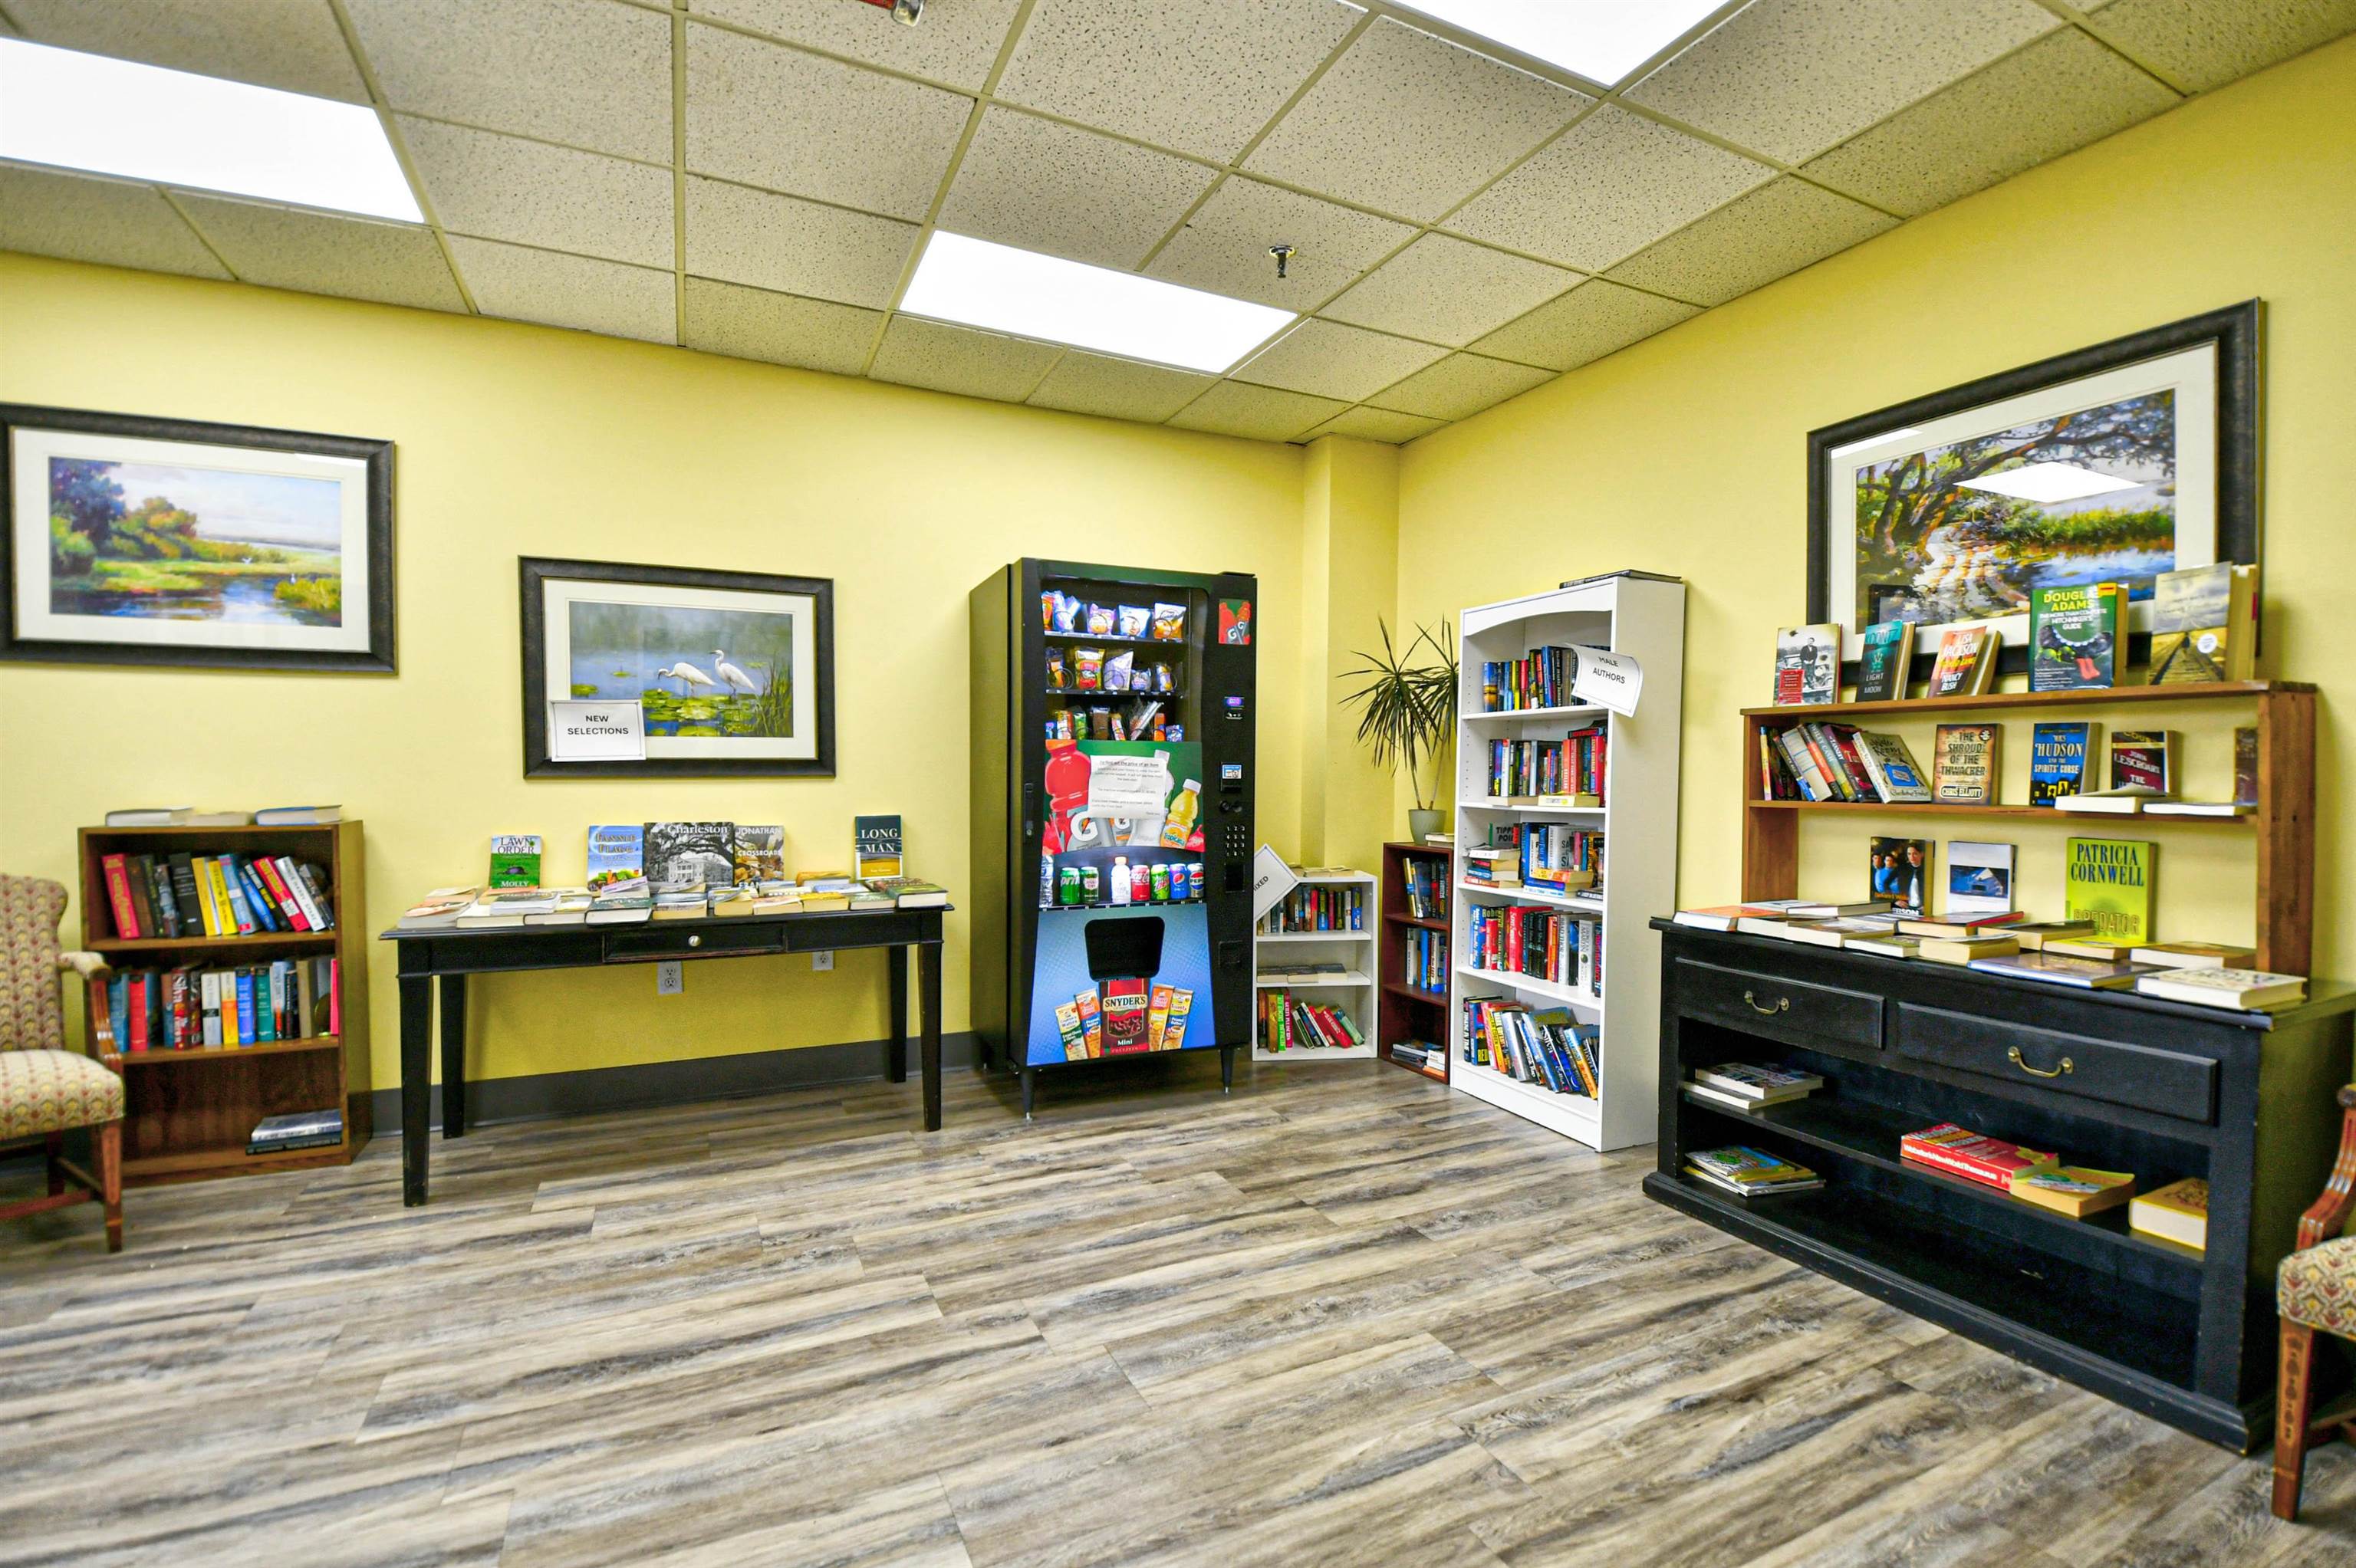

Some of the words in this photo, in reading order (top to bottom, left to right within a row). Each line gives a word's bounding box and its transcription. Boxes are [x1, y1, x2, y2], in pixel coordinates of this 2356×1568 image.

[2044, 590, 2098, 603] DOUGLA
[2052, 600, 2095, 611] ADAMS
[1957, 633, 1973, 643] LISA
[1943, 643, 1979, 657] JACKSON
[1598, 656, 1618, 667] MALE
[1593, 667, 1626, 684] AUTHORS
[1941, 672, 1963, 683] NANCY
[568, 727, 629, 735] SELECTIONS
[1959, 732, 1976, 742] THE
[1948, 743, 1983, 753] SHROUD
[2035, 743, 2083, 757] HUDSON
[1950, 754, 1959, 764] OF
[1965, 755, 1979, 764] THE
[1941, 766, 1986, 775] THWACKER
[2130, 774, 2146, 784] THE
[1942, 787, 1958, 797] CHRIS
[1959, 787, 1983, 797] ELLIOTT
[667, 824, 728, 833] Charleston
[1071, 811, 1098, 841] G
[596, 833, 636, 843] FANNIE
[861, 828, 898, 839] LONG
[501, 837, 532, 846] LAWN
[498, 846, 535, 854] ORDER
[598, 844, 633, 853] FLAGG
[865, 843, 896, 853] MAN
[2076, 843, 2139, 866] PATRICIA
[2071, 863, 2144, 886] CORNWELL
[2073, 909, 2140, 935] PREDATOR
[172, 975, 187, 1002] Silva
[1104, 996, 1146, 1008] SNYDER'S
[1542, 1031, 1556, 1054] Silva
